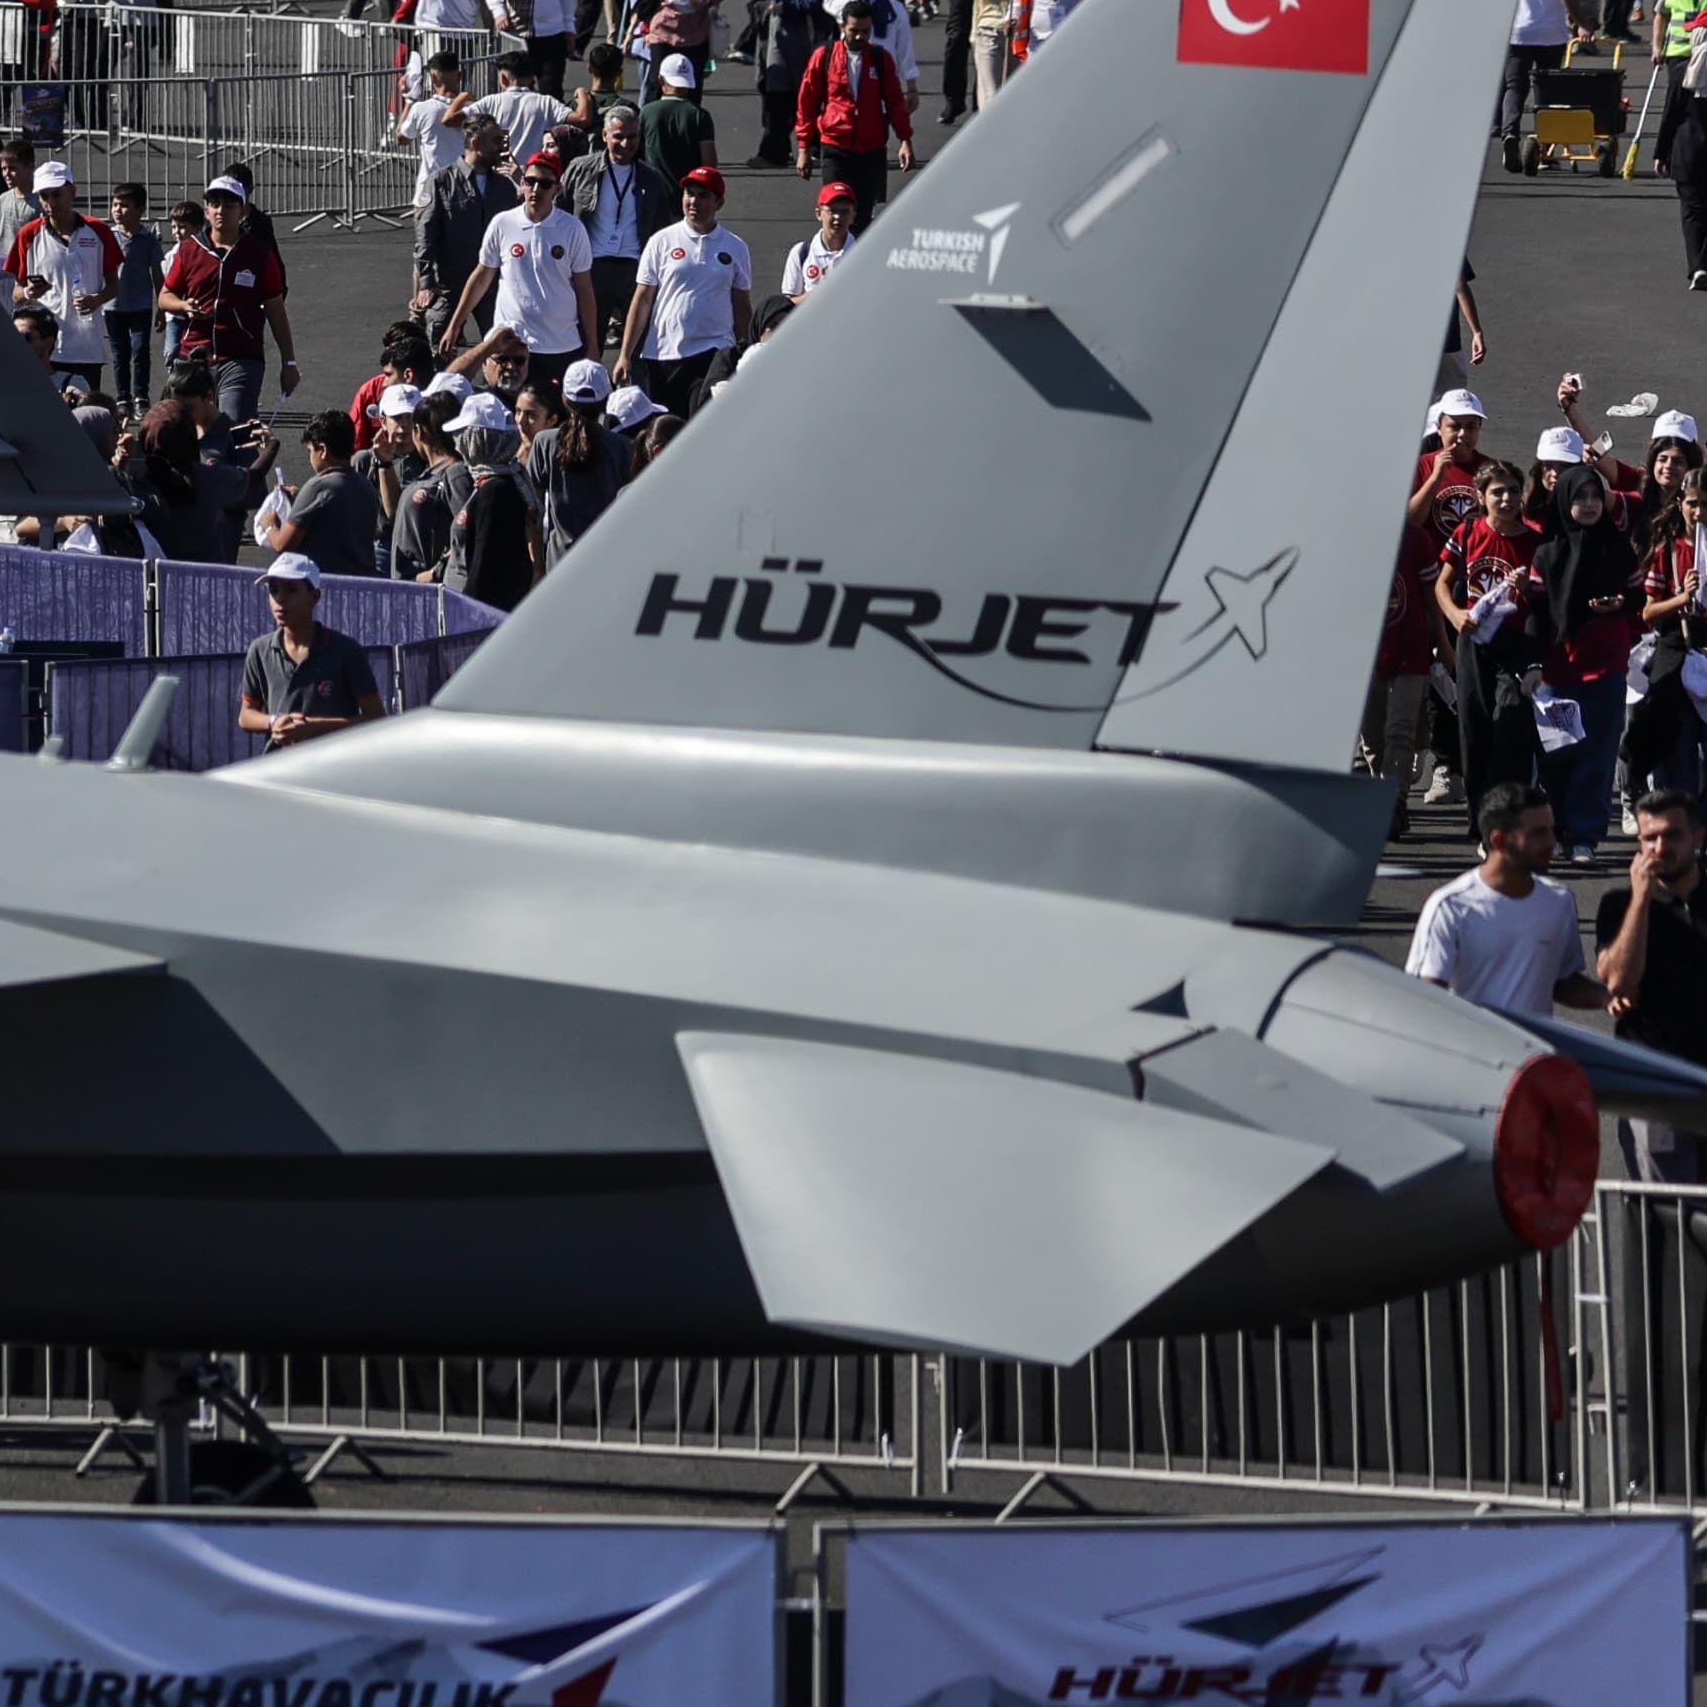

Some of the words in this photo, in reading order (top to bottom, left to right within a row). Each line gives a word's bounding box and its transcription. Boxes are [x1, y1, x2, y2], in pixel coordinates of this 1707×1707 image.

[912, 228, 985, 254] TURKISH
[886, 247, 979, 274] AEROSPACE
[635, 556, 1183, 670] HÜRJET
